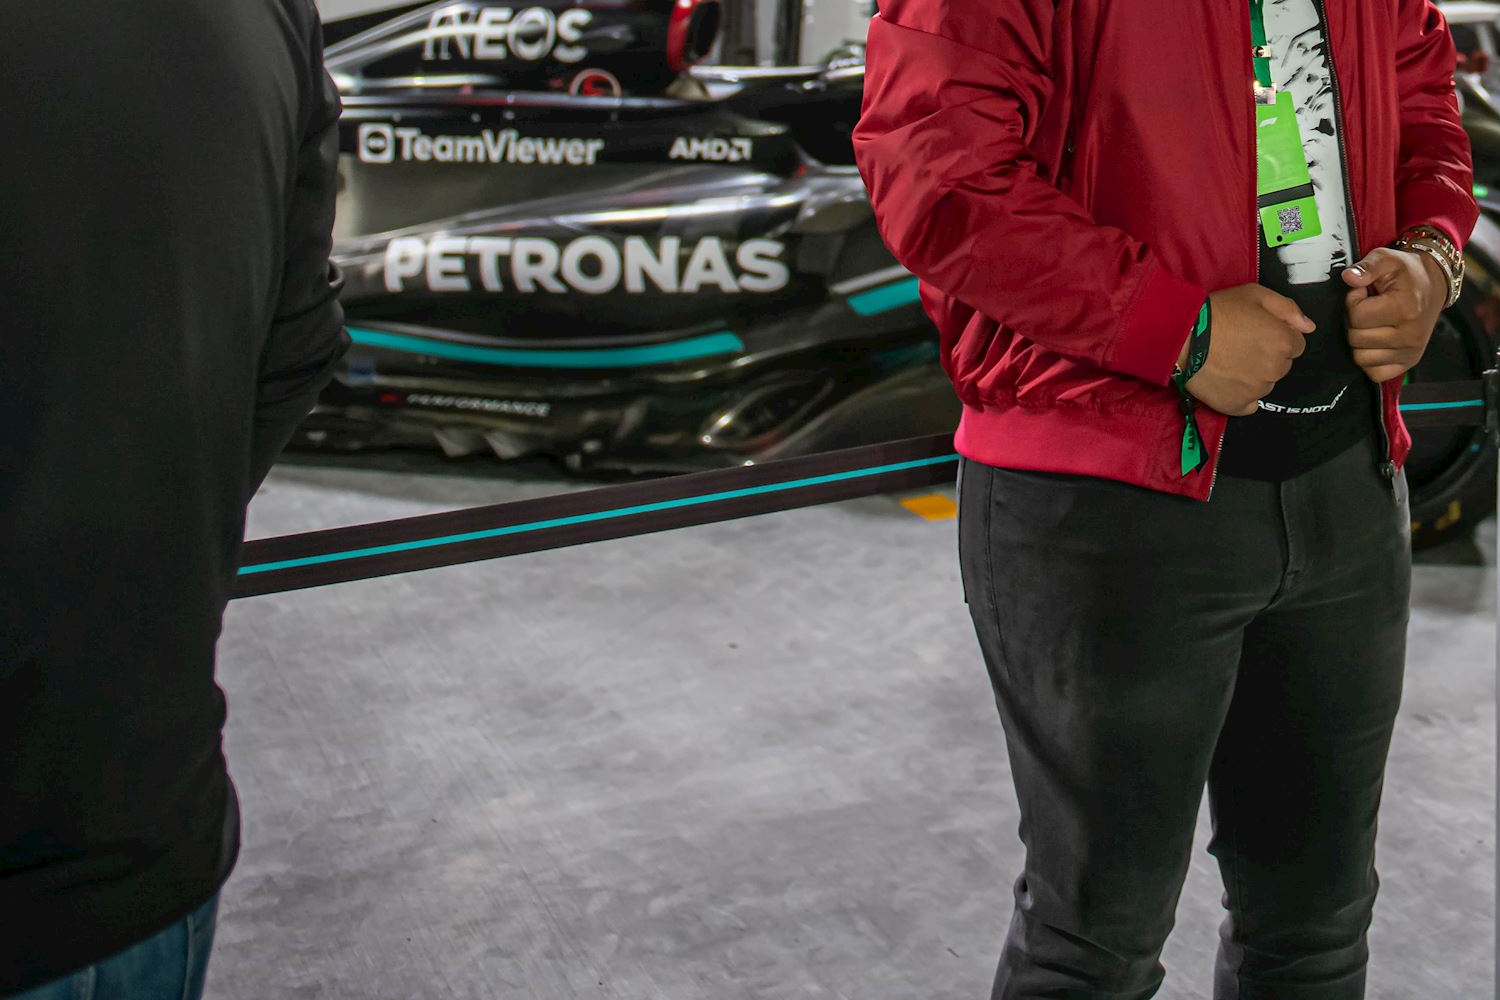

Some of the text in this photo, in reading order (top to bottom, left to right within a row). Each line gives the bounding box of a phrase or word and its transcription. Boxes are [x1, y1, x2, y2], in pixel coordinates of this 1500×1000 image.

[423, 3, 593, 63] INEOS
[396, 127, 604, 164] TeamViewer
[669, 137, 729, 161] AMD
[383, 236, 789, 294] PETRONAS
